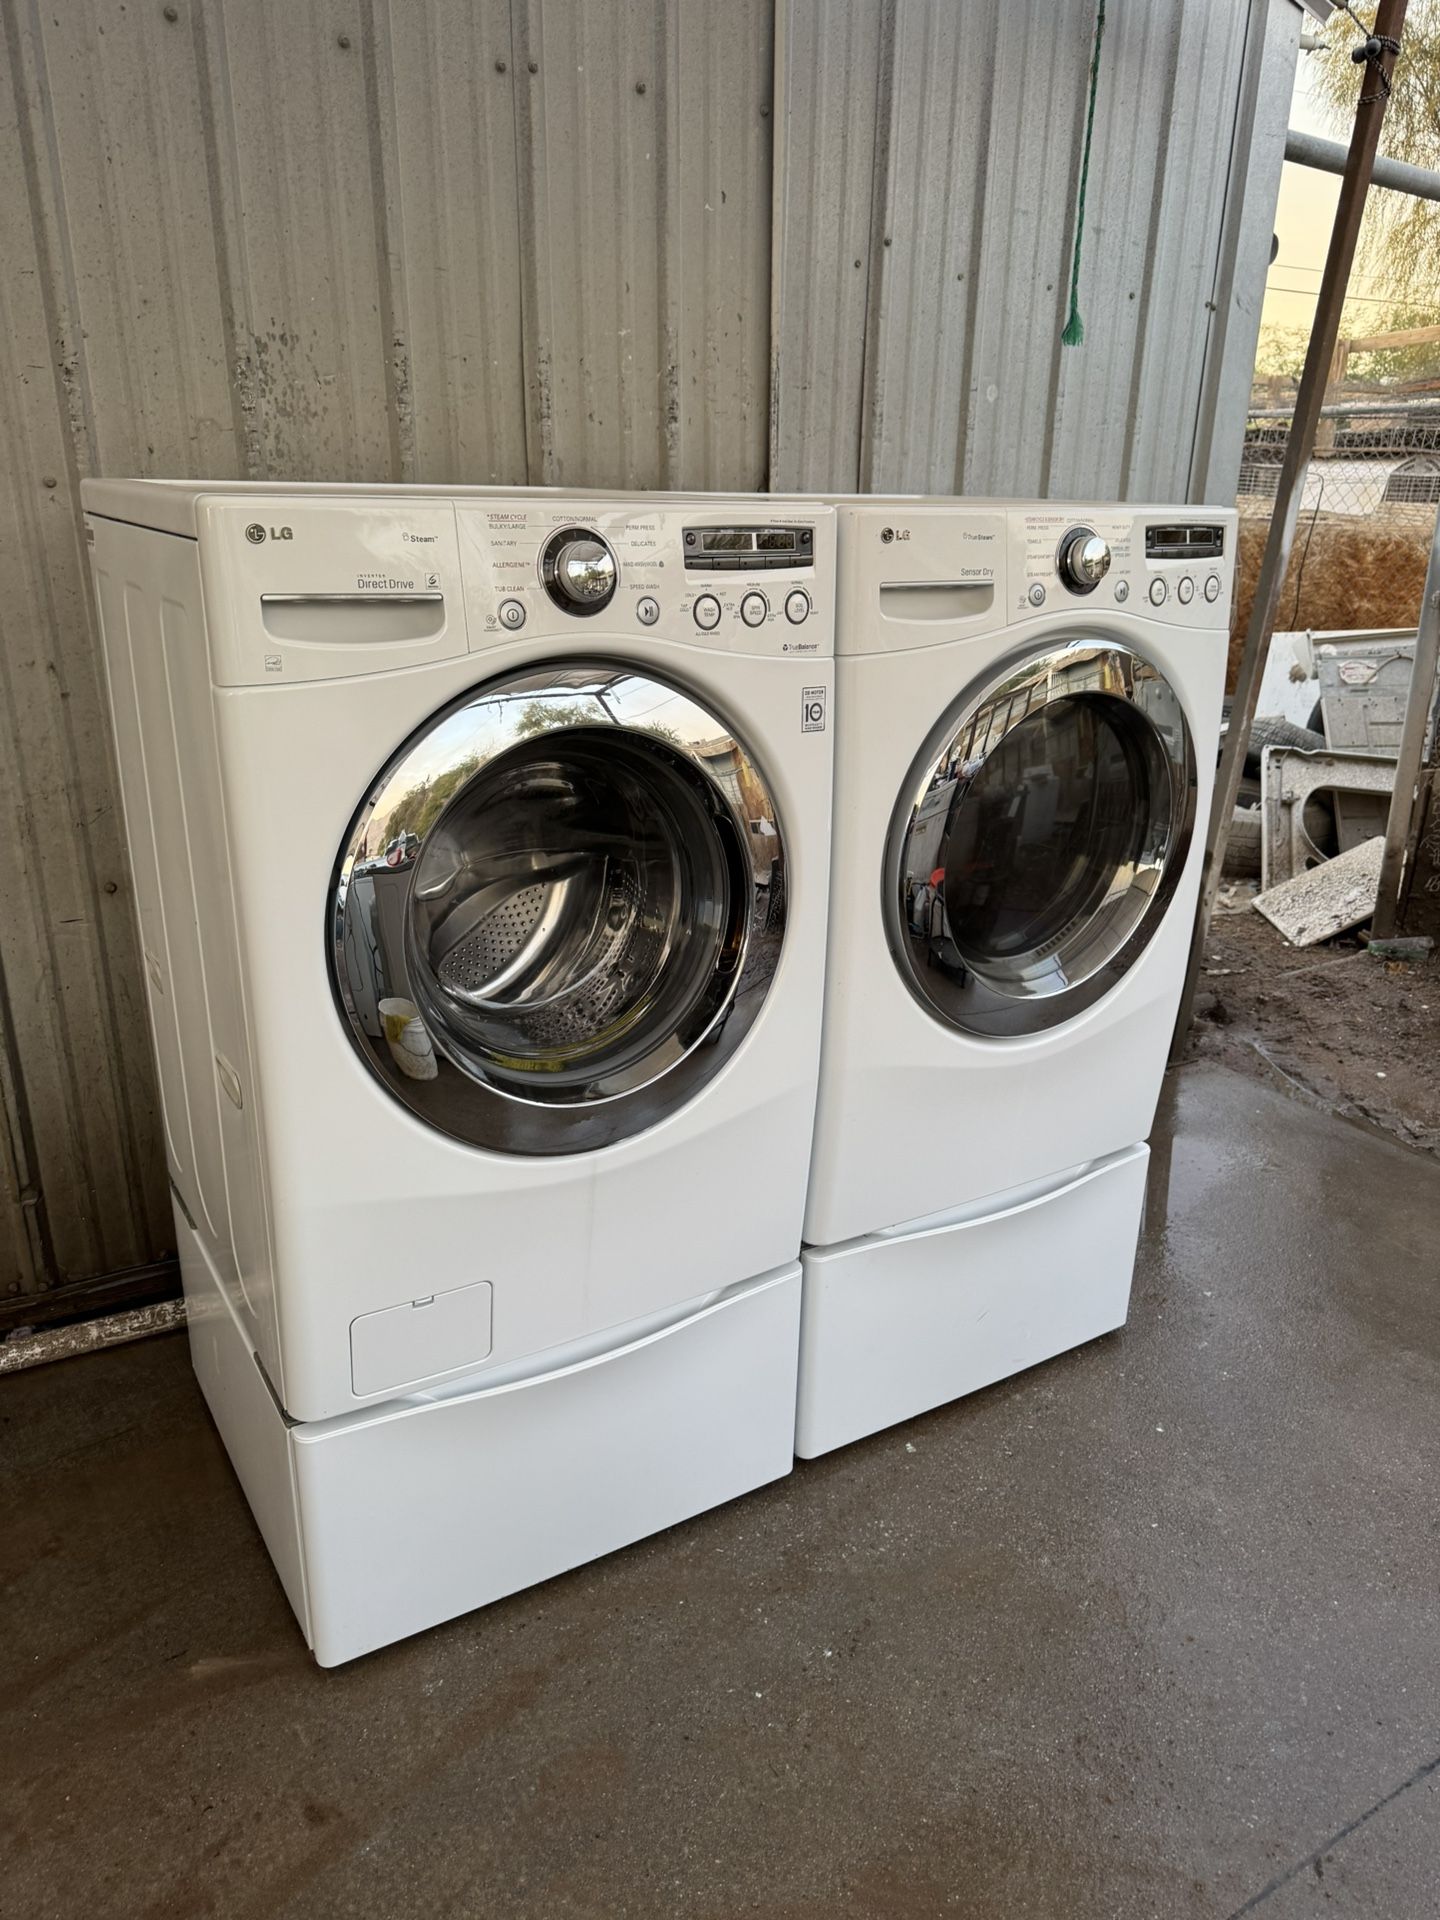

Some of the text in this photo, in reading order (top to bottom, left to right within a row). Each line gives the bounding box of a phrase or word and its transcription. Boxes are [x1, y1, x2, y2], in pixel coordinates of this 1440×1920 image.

[510, 513, 527, 521] CYCLE
[270, 527, 294, 540] LG
[896, 529, 911, 541] LG
[960, 568, 994, 577] Sensor Dry
[357, 579, 414, 589] Direct Drive
[805, 702, 823, 722] 10
